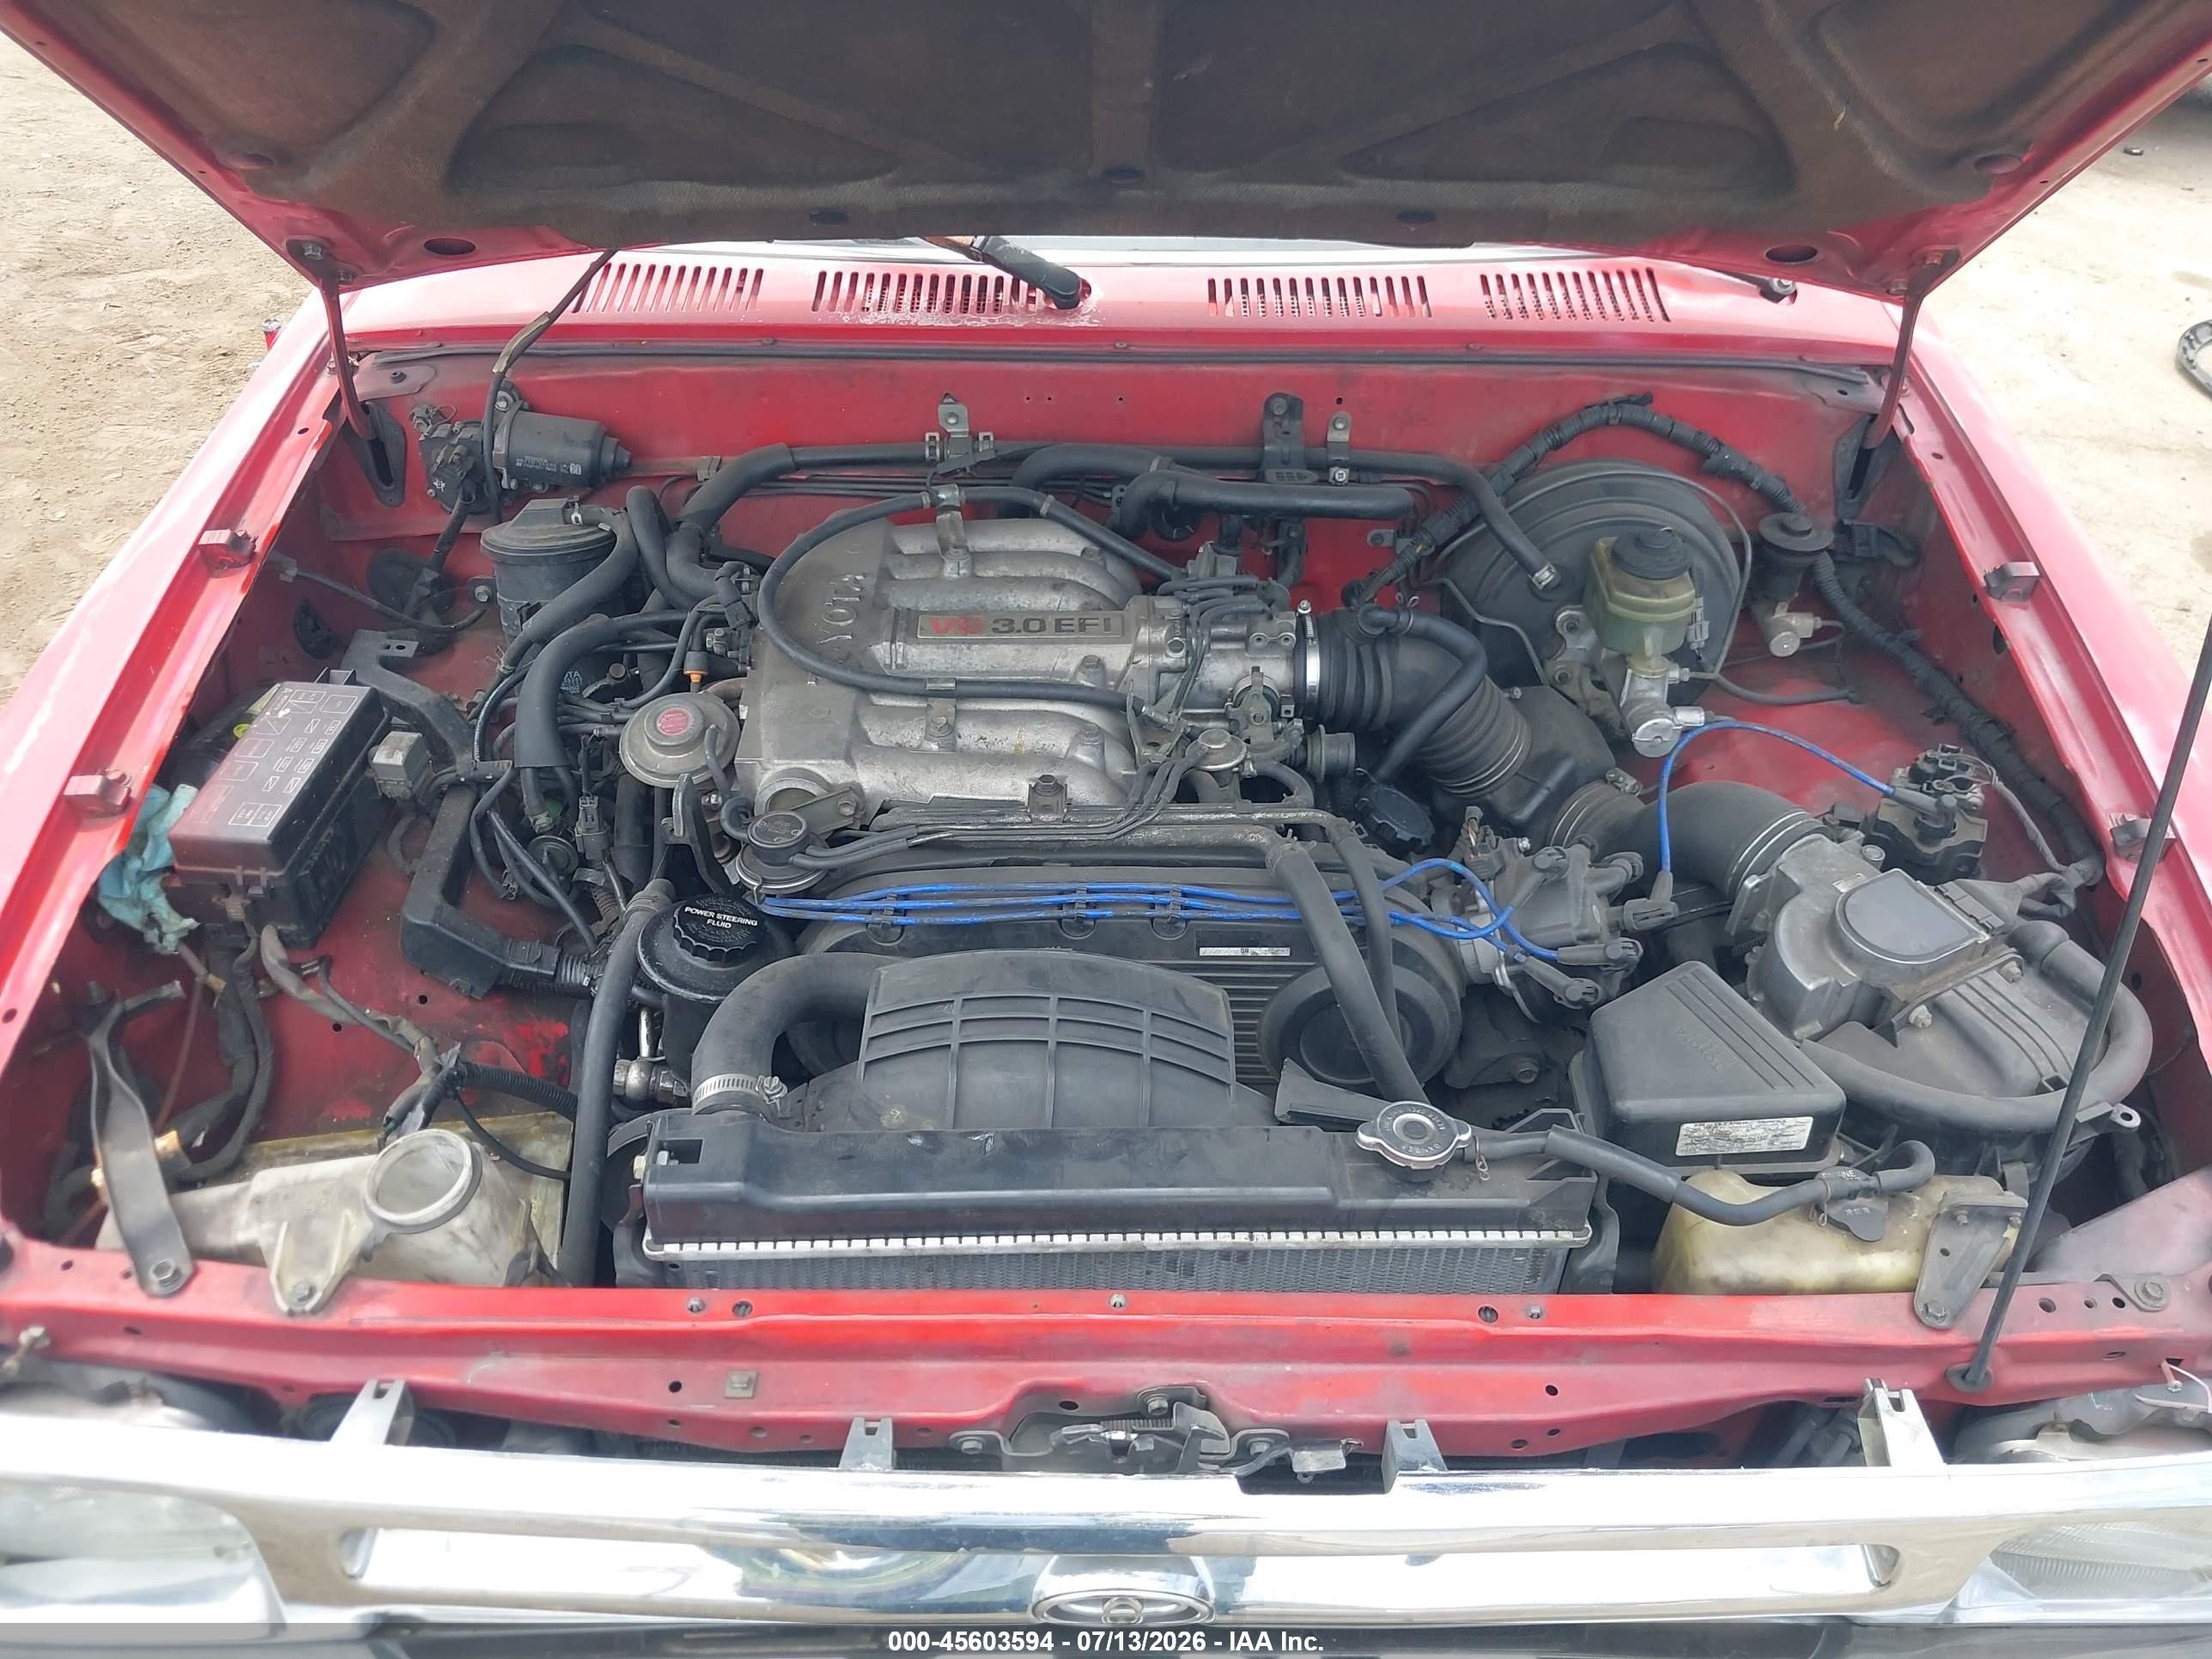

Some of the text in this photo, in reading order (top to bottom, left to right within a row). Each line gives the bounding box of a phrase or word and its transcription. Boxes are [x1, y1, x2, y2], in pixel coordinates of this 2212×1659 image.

[930, 617, 1114, 635] V6 3.0 EFI
[684, 906, 714, 918] POWER
[716, 913, 757, 926] STEERING
[707, 919, 732, 928] FLUID
